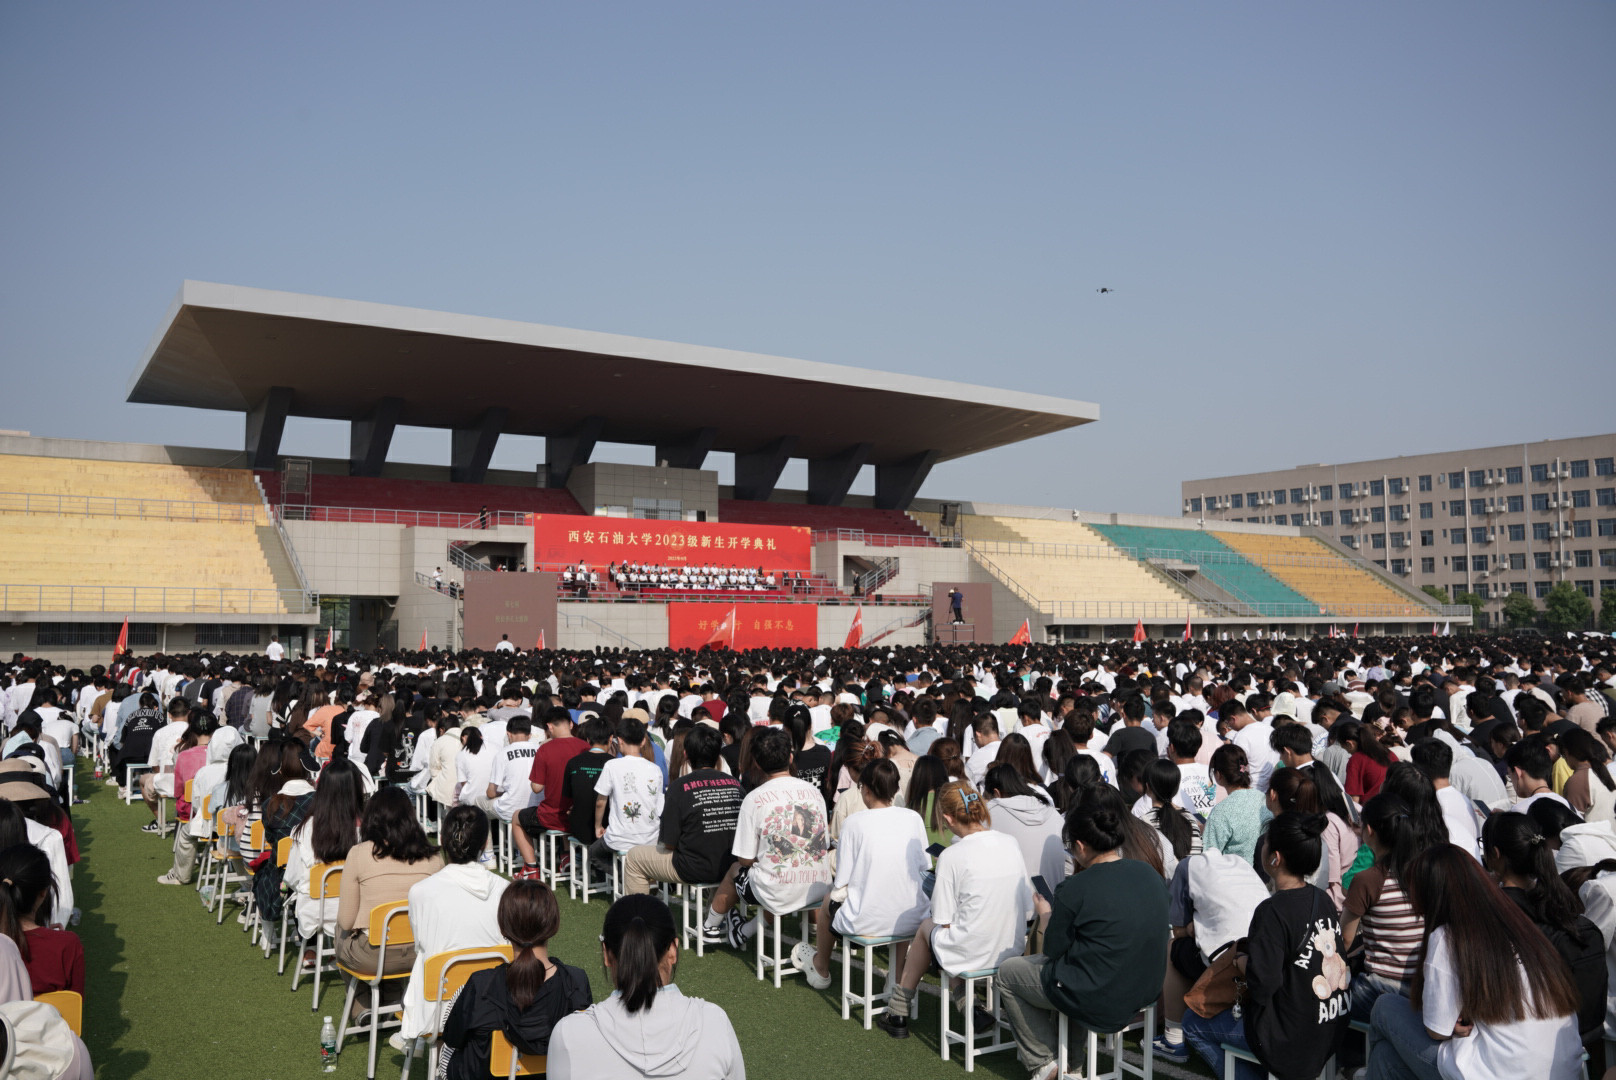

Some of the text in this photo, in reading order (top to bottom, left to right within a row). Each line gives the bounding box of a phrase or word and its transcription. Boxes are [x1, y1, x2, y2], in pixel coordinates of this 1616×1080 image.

[568, 530, 777, 550] 西安石油大学2023级新生开学典礼
[753, 619, 795, 631] 自强不息
[798, 869, 818, 883] TOUR
[1318, 990, 1353, 1024] ADLV
